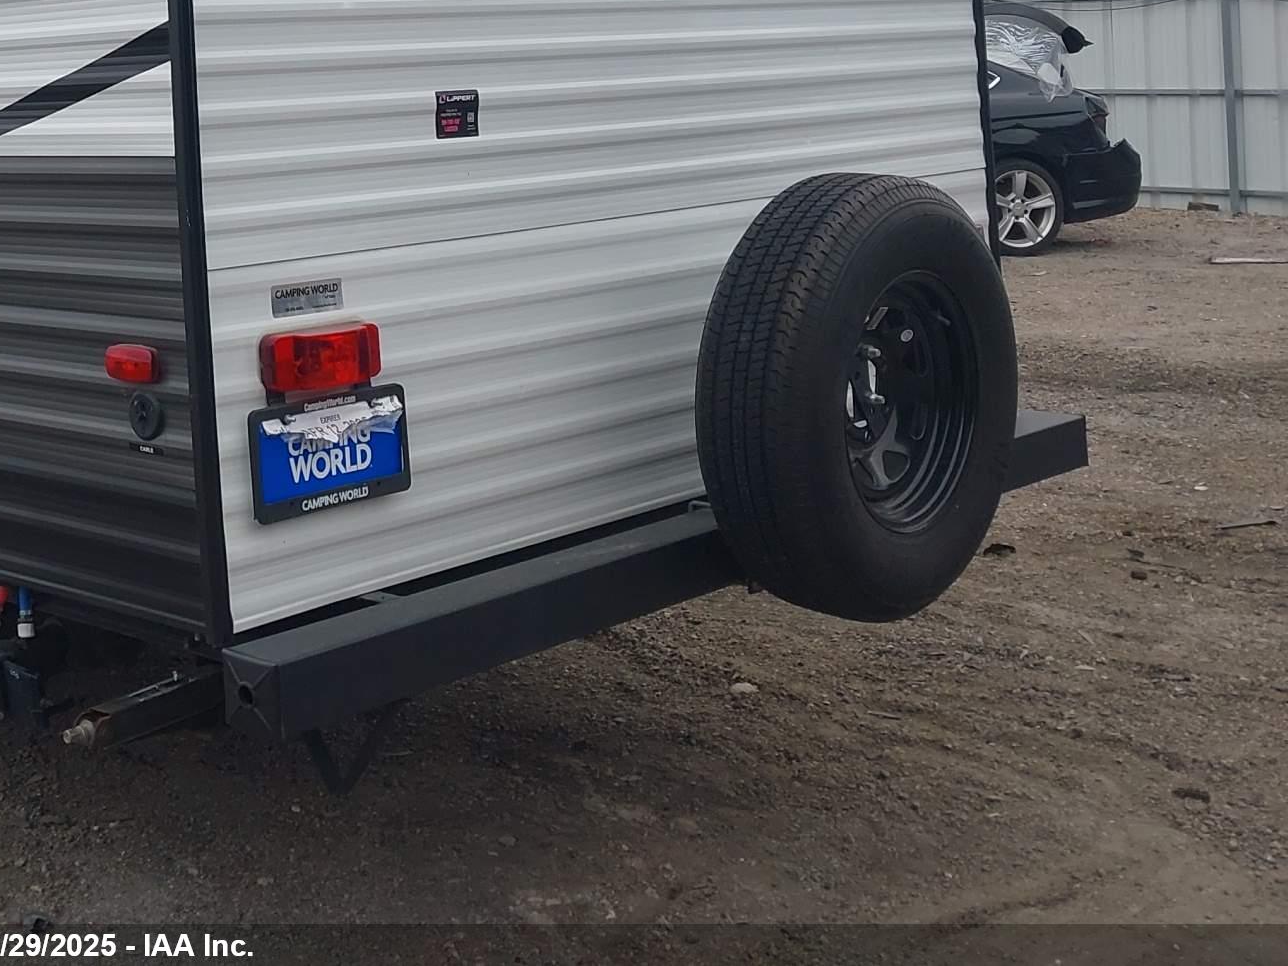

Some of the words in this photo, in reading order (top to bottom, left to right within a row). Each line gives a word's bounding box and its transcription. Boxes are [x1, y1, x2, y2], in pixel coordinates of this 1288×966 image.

[274, 285, 310, 299] CAMPING
[310, 283, 339, 295] WORLD
[289, 444, 372, 484] WORLD
[301, 493, 339, 512] CAMPING
[339, 485, 369, 502] WORLD
